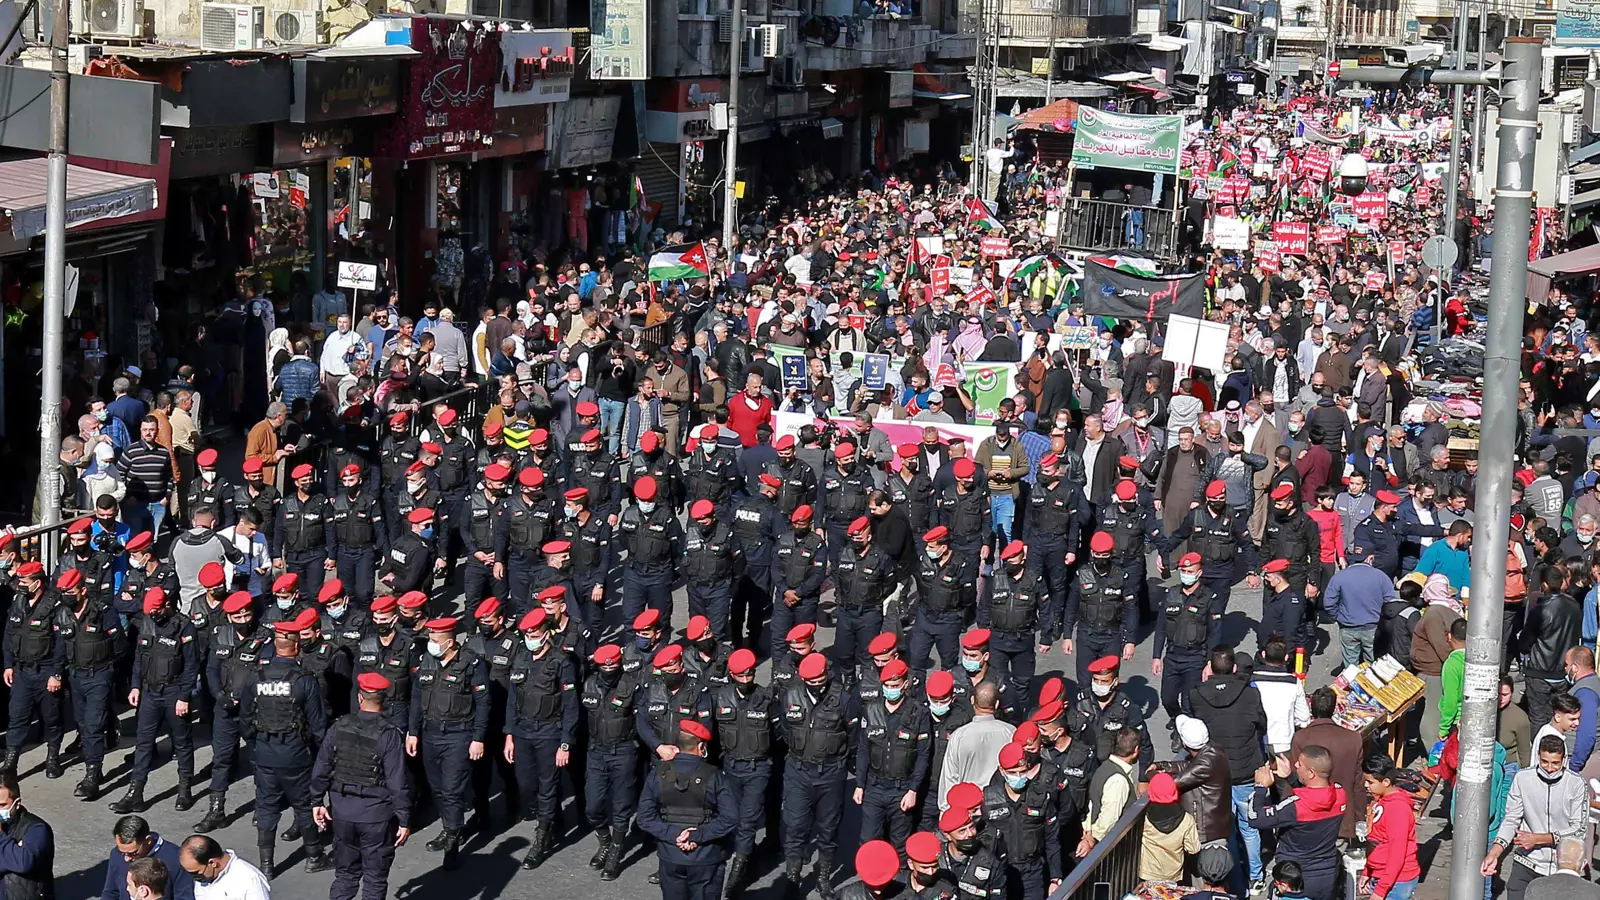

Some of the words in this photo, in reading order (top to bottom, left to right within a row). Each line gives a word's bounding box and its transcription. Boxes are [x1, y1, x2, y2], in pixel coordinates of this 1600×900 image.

[1548, 499, 1562, 510] 55
[735, 509, 761, 523] POLICE
[391, 548, 407, 564] POLICE
[257, 680, 291, 696] POLICE
